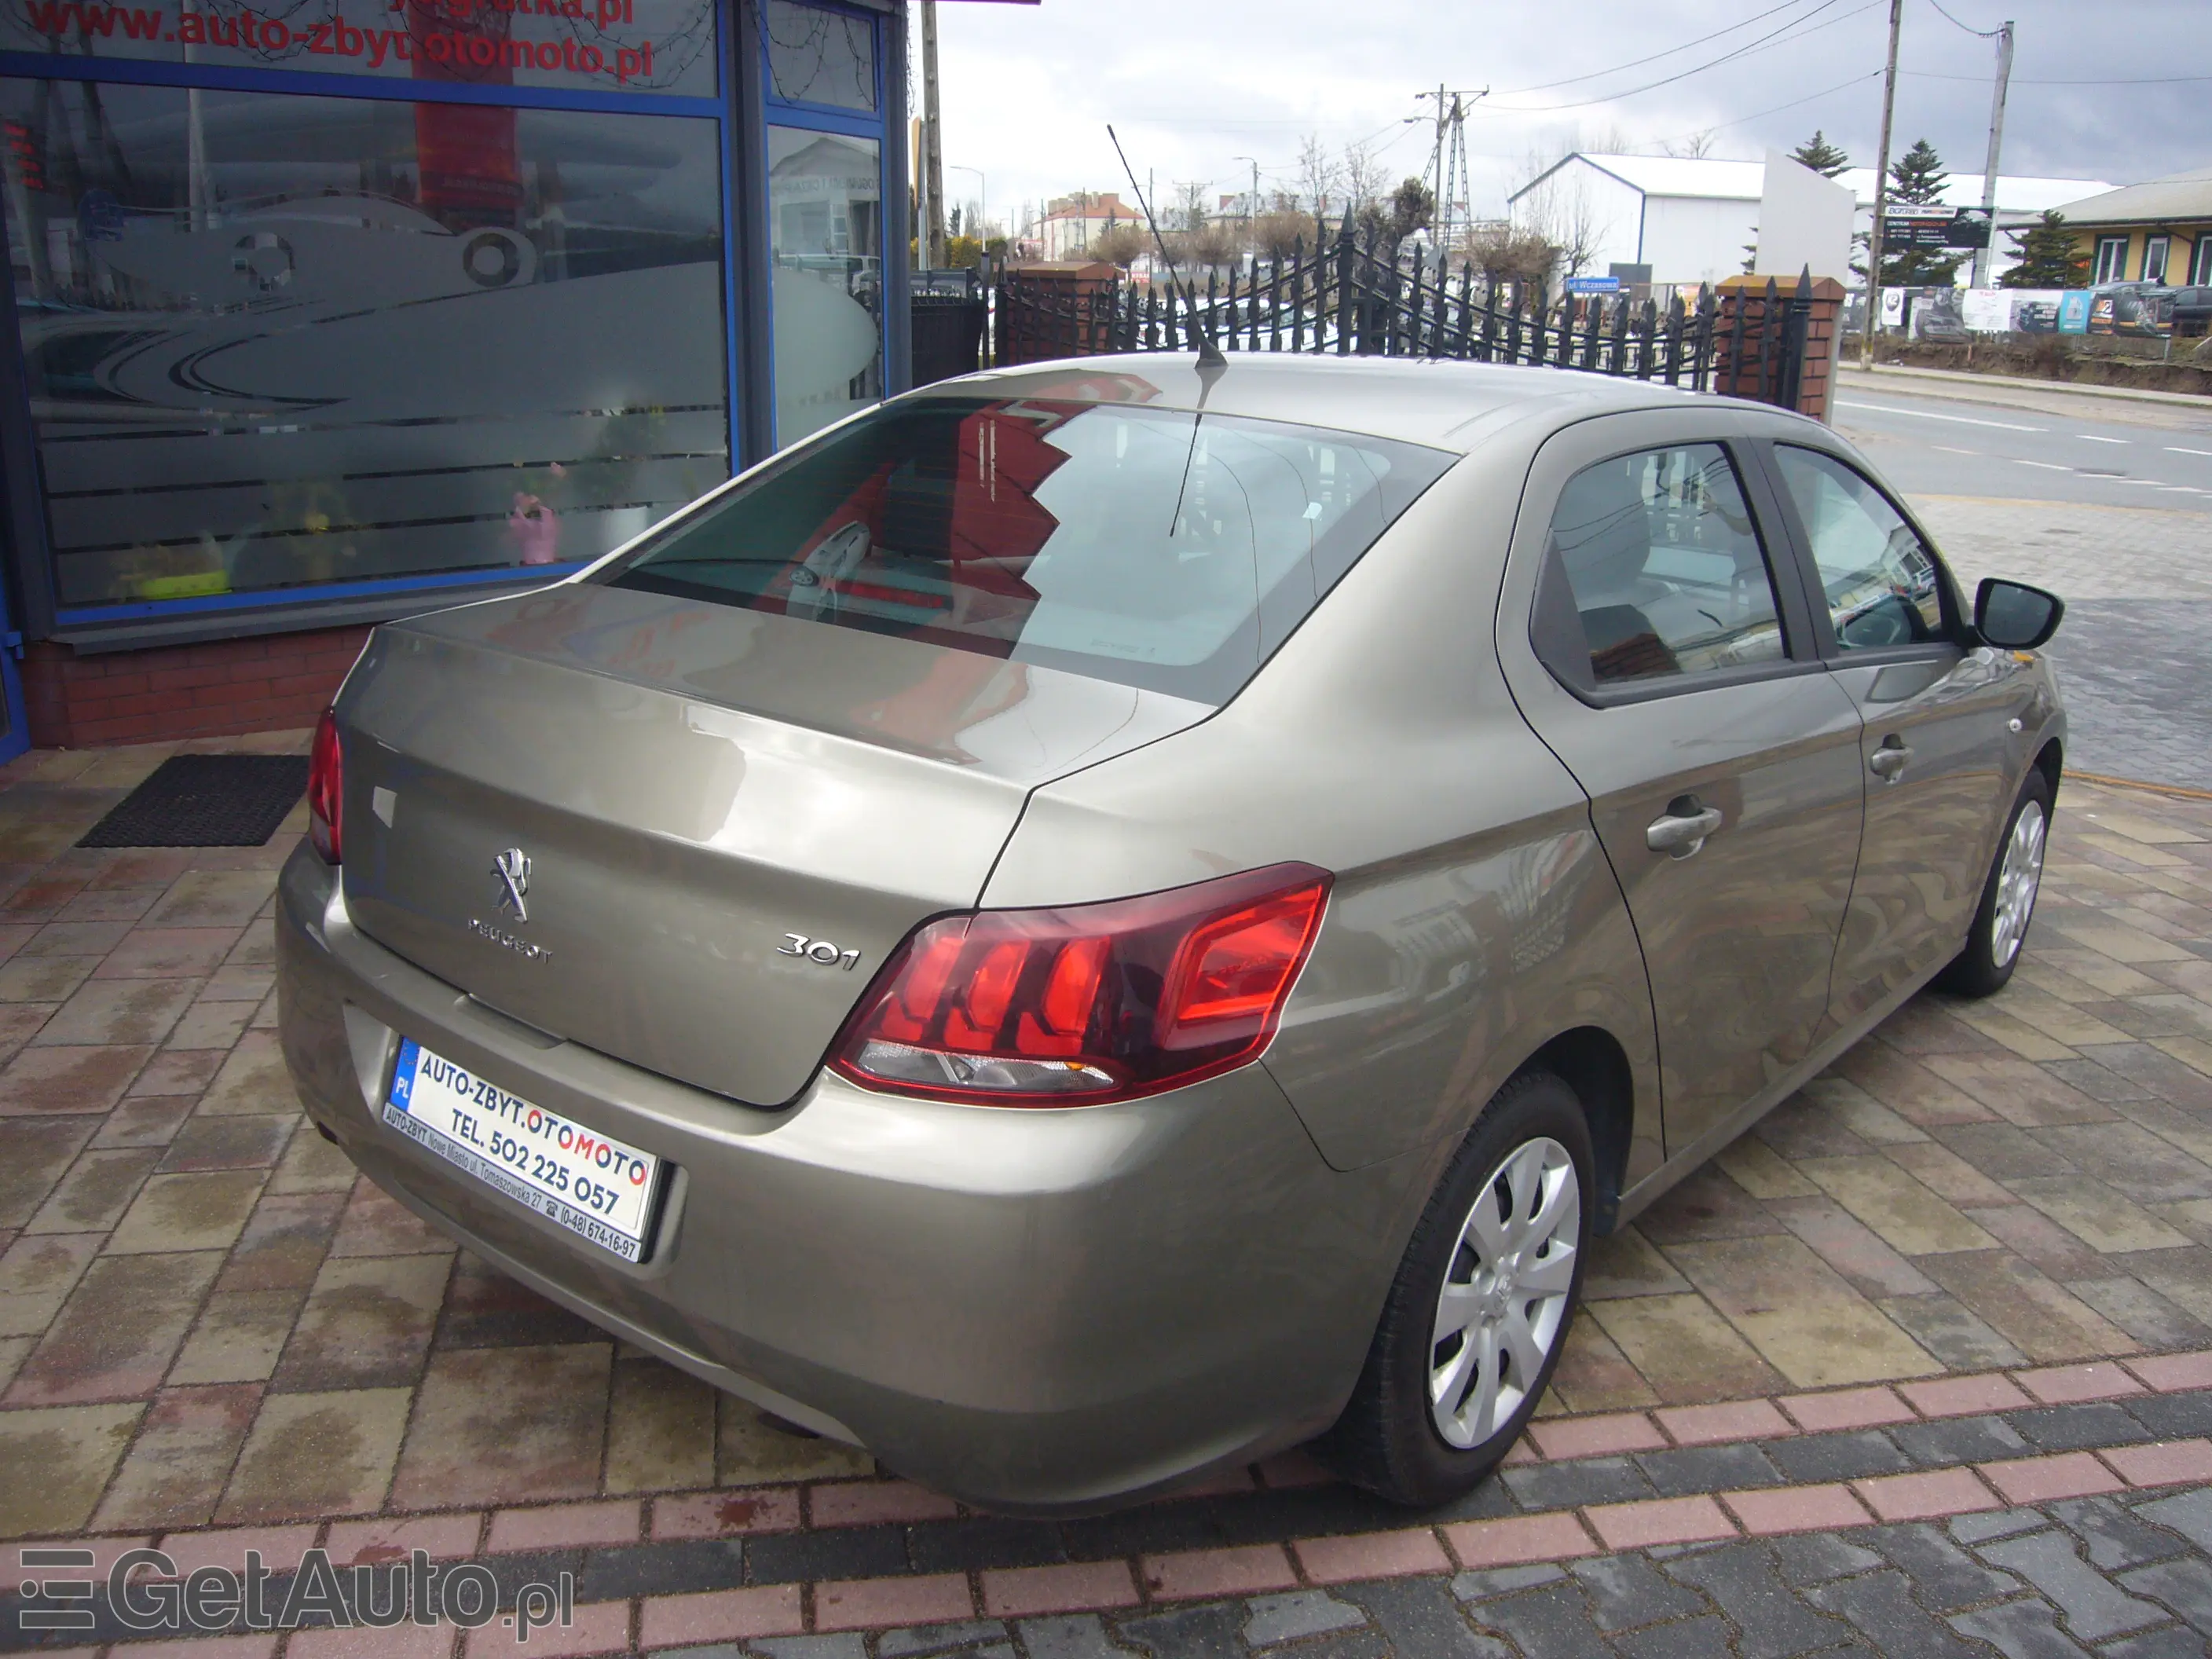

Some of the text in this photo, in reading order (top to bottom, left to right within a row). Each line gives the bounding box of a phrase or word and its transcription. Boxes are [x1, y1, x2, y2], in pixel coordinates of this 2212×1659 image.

[27, 1, 652, 83] www.auto-zbyt.otomoto.pl
[468, 919, 553, 964] PEUGEOT
[776, 932, 861, 971] 301
[396, 1076, 409, 1098] PL
[421, 1054, 646, 1185] AUTO-ZBYT.OTOMOTO
[386, 1107, 635, 1258] AUTO-ZBYT Nowe Miasto ul. Tomaszowska 27 (0-48) 674-16-97
[452, 1108, 485, 1148] TEL.
[489, 1130, 529, 1170] 502
[532, 1154, 570, 1191] 225
